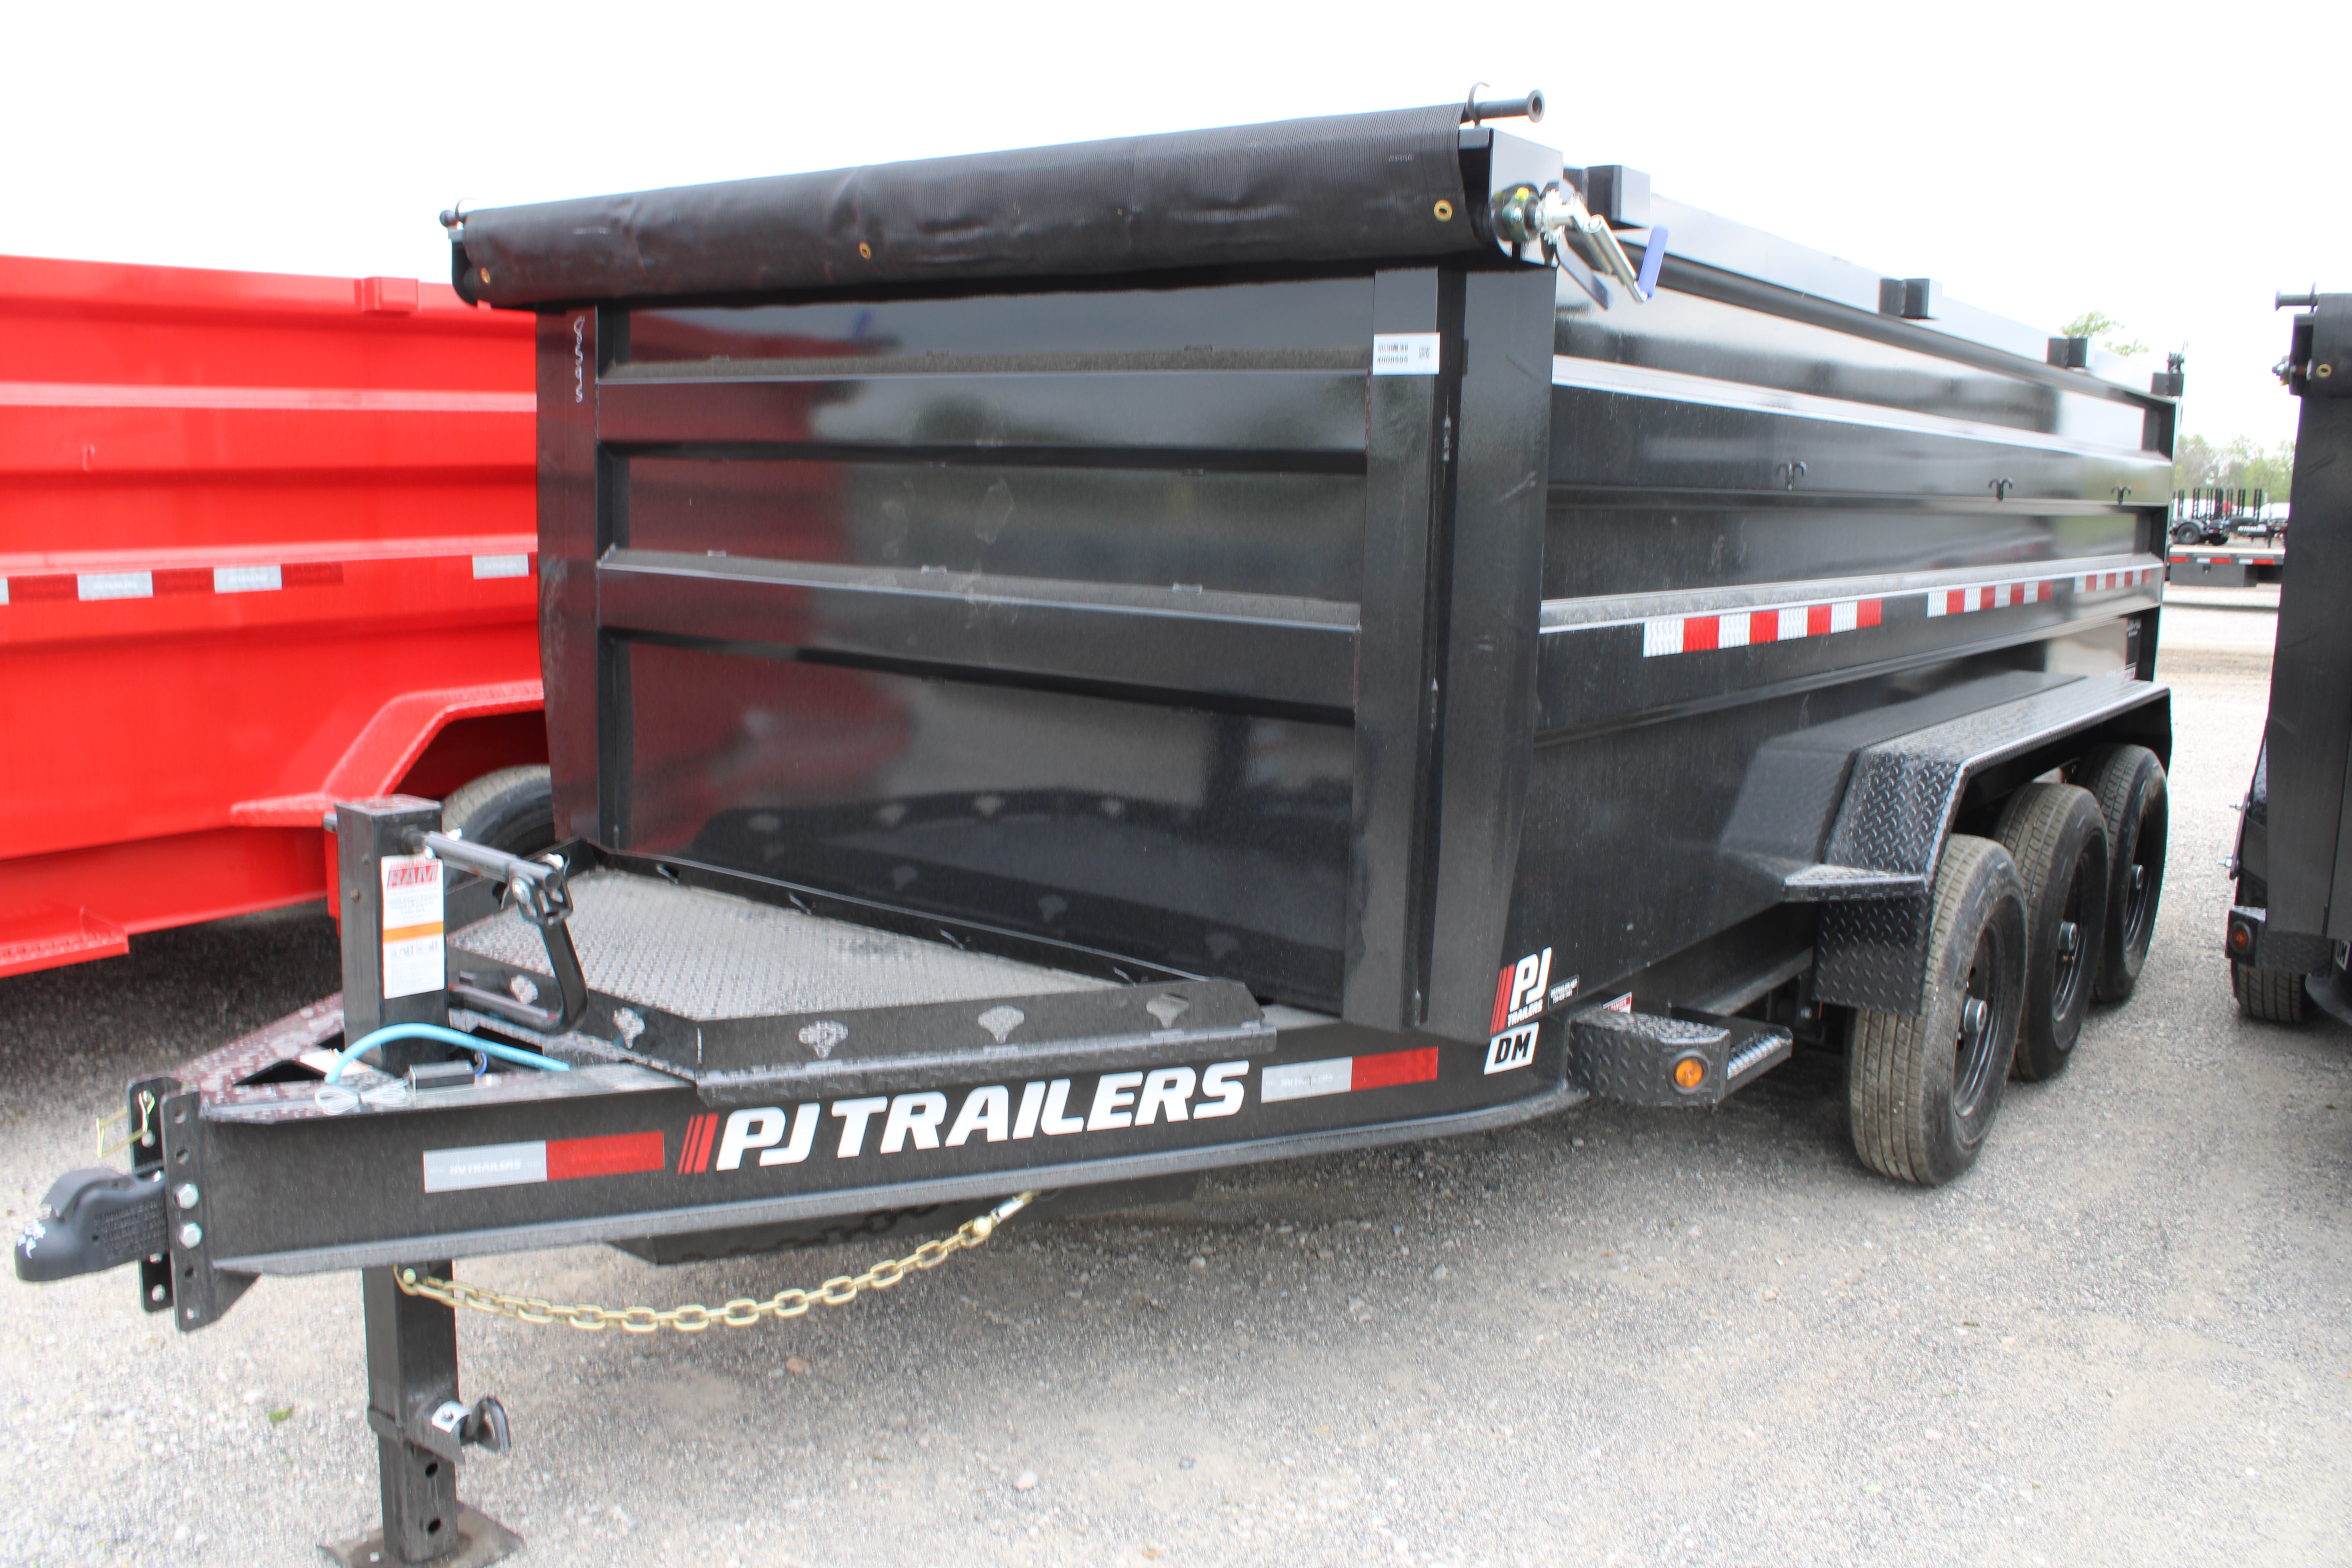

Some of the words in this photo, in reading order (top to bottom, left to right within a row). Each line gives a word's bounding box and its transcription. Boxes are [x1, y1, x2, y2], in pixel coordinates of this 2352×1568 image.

[387, 865, 438, 887] RAM
[1509, 947, 1552, 1013] PJ
[1508, 998, 1543, 1027] TRAILERS
[1494, 1032, 1531, 1067] DM
[716, 1103, 820, 1171] PJ
[831, 1060, 1250, 1159] TRAILERS
